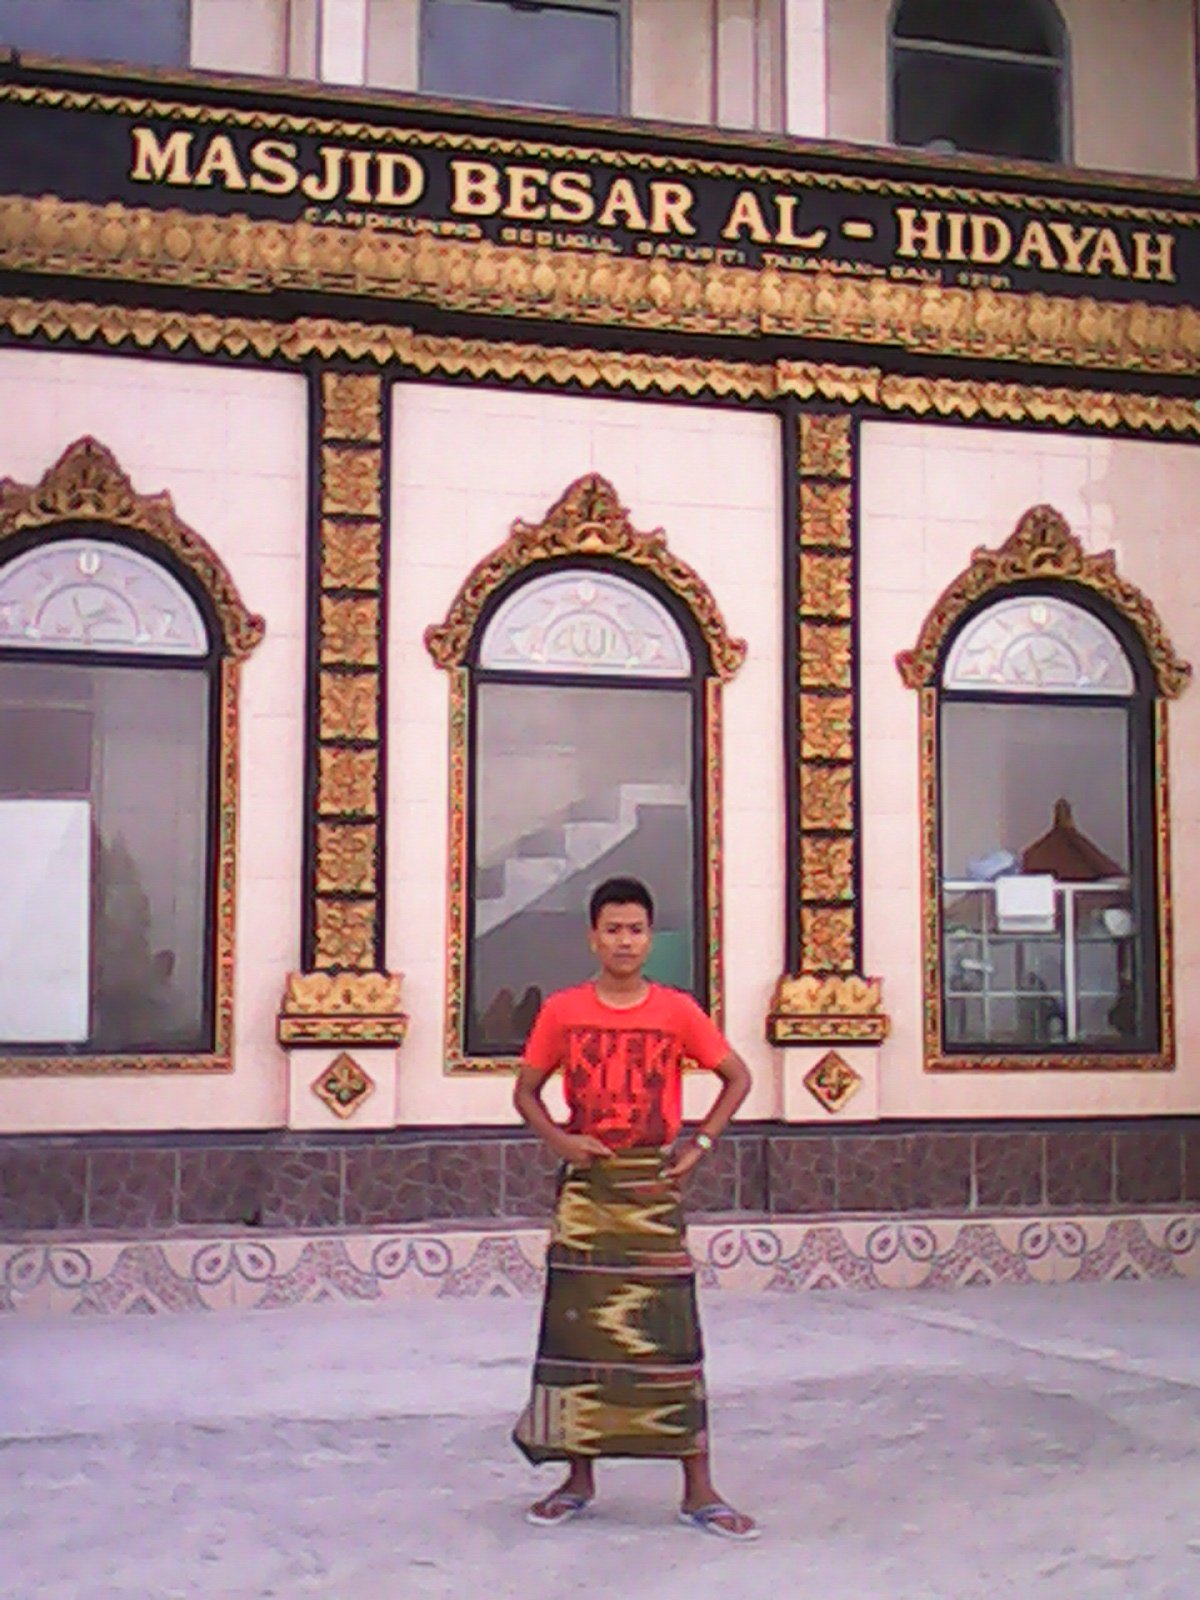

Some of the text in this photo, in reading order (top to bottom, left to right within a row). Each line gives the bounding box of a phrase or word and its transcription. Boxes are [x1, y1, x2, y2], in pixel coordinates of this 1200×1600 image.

[131, 127, 425, 206] MASJID
[450, 160, 695, 236] BESAR
[721, 190, 828, 248] AL
[896, 206, 1176, 282] HIDAYAH
